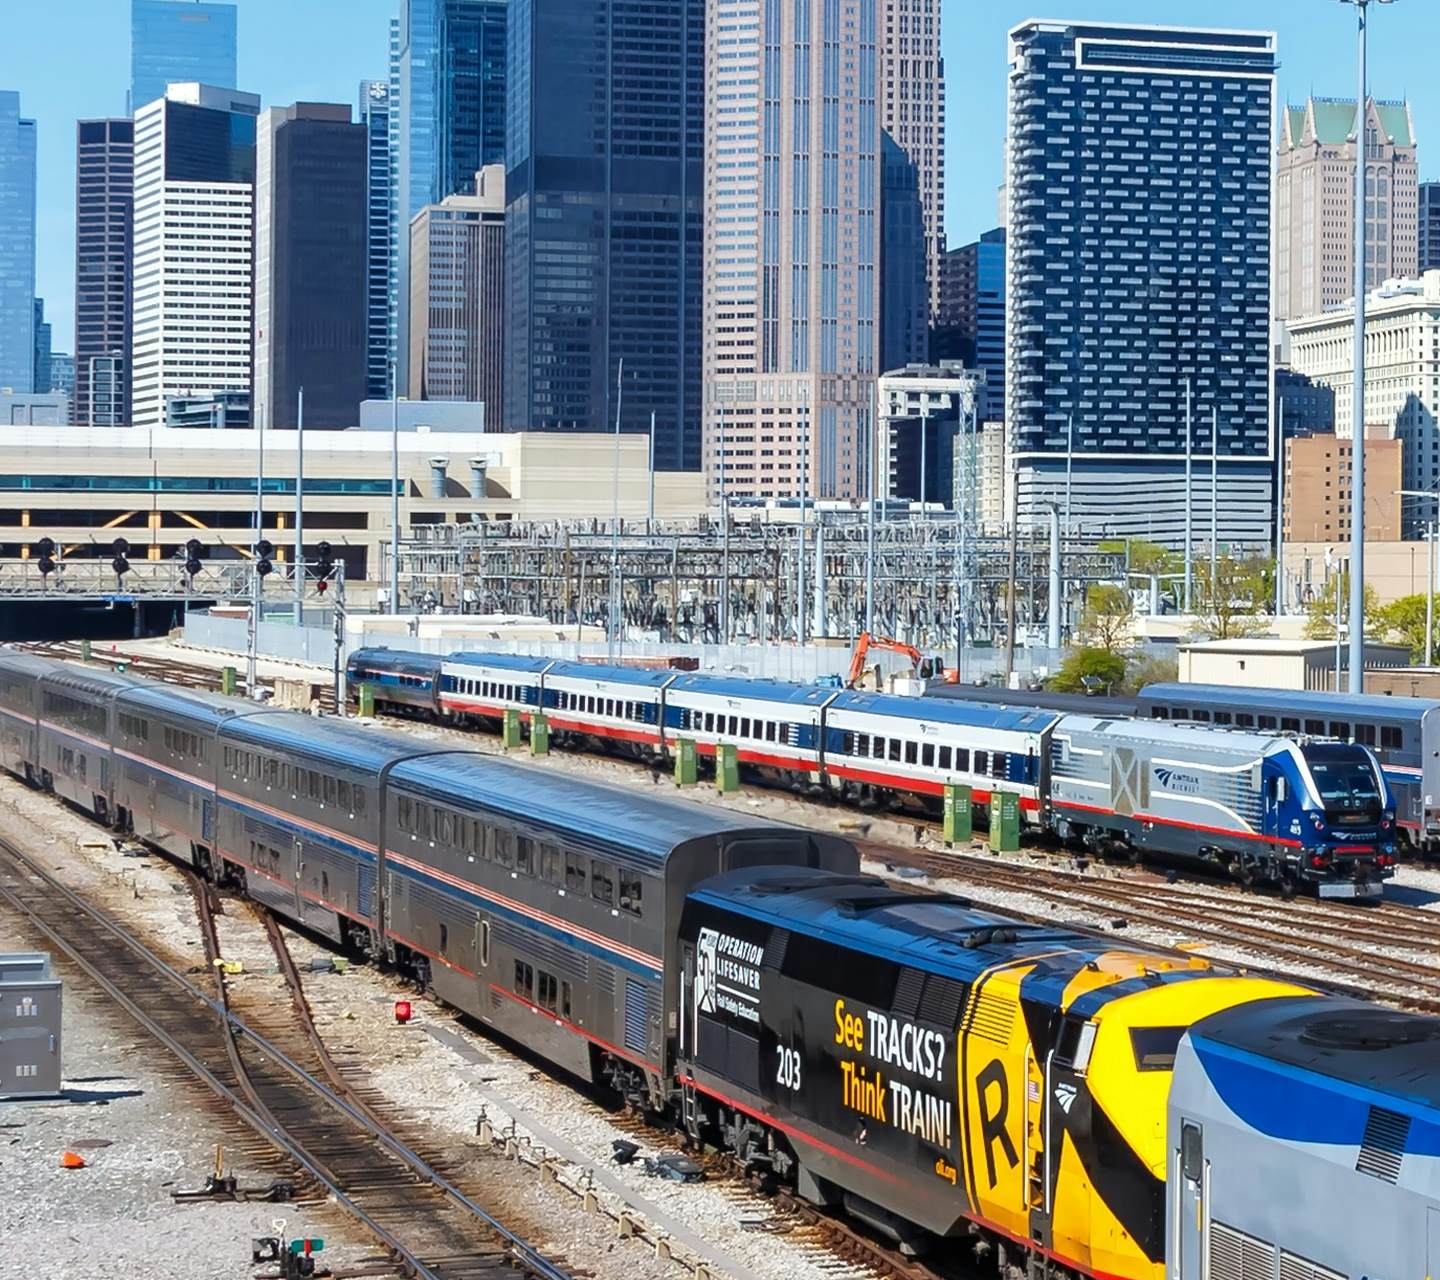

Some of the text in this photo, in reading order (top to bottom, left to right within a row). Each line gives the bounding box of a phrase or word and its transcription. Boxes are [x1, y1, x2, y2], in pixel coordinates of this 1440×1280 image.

[718, 933, 764, 966] OPERATION
[717, 957, 760, 990] LIFESAVER
[835, 999, 945, 1081] See TRACKS?
[776, 1044, 801, 1091] 203
[841, 1060, 951, 1149] Think TRAIN!
[935, 1158, 957, 1185] oli.org
